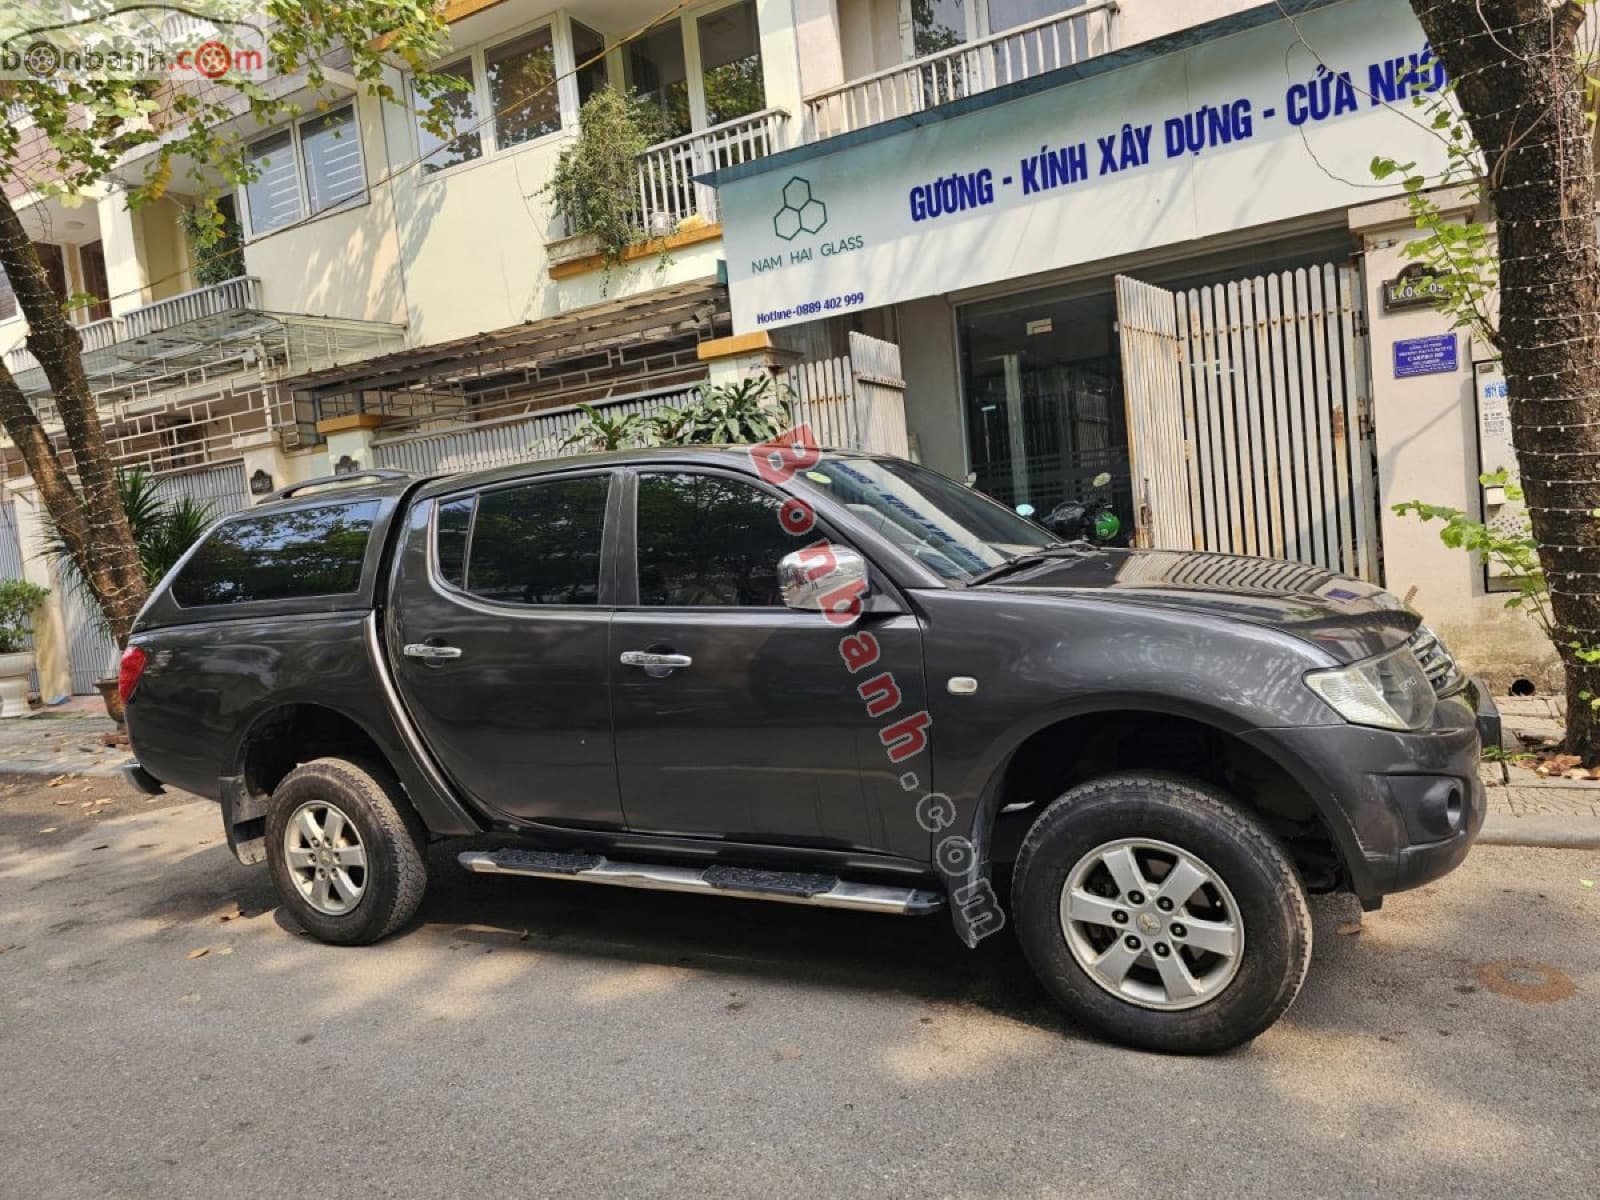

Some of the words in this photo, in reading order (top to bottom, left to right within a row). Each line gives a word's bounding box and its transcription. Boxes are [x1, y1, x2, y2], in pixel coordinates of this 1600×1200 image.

[909, 168, 994, 222] GƯƠNG
[1002, 176, 1013, 185] -
[1020, 143, 1088, 195] KÍNH
[1097, 123, 1153, 176] XÂY
[1164, 99, 1253, 158] DỰNG
[1263, 108, 1276, 119] -
[1286, 63, 1358, 126] CỬA
[751, 255, 783, 273] NAM
[790, 248, 813, 264] HAI
[820, 236, 864, 257] GLASS
[824, 296, 842, 310] 402
[844, 292, 865, 307] 999
